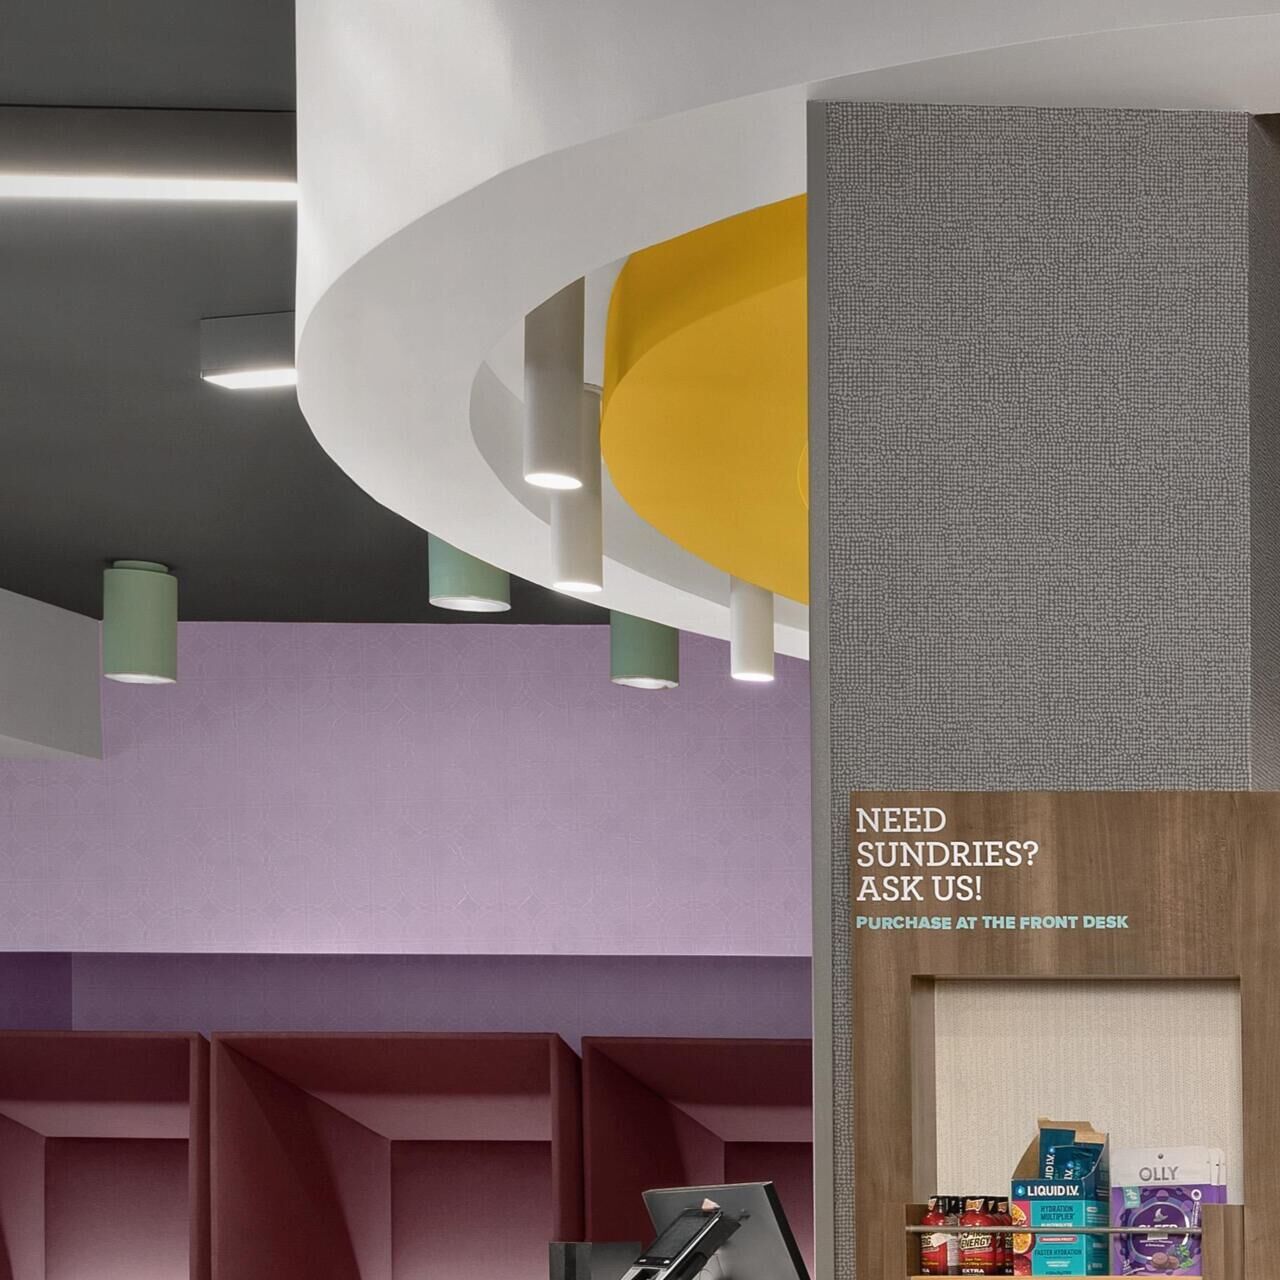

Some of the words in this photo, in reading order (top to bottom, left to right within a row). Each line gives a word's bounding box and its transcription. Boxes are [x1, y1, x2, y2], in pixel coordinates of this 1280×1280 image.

[856, 807, 947, 832] NEED
[857, 841, 1039, 867] SUNDRIES?
[856, 875, 924, 901] ASK
[931, 875, 982, 901] US!
[856, 916, 951, 929] PURCHASE
[956, 917, 977, 929] AT
[982, 916, 1016, 929] THE
[1020, 916, 1078, 929] FRONT
[1083, 915, 1129, 929] DESK
[1139, 1166, 1179, 1182] OLLY
[1027, 1184, 1065, 1197] LIQUID
[960, 1236, 991, 1249] ENERGY
